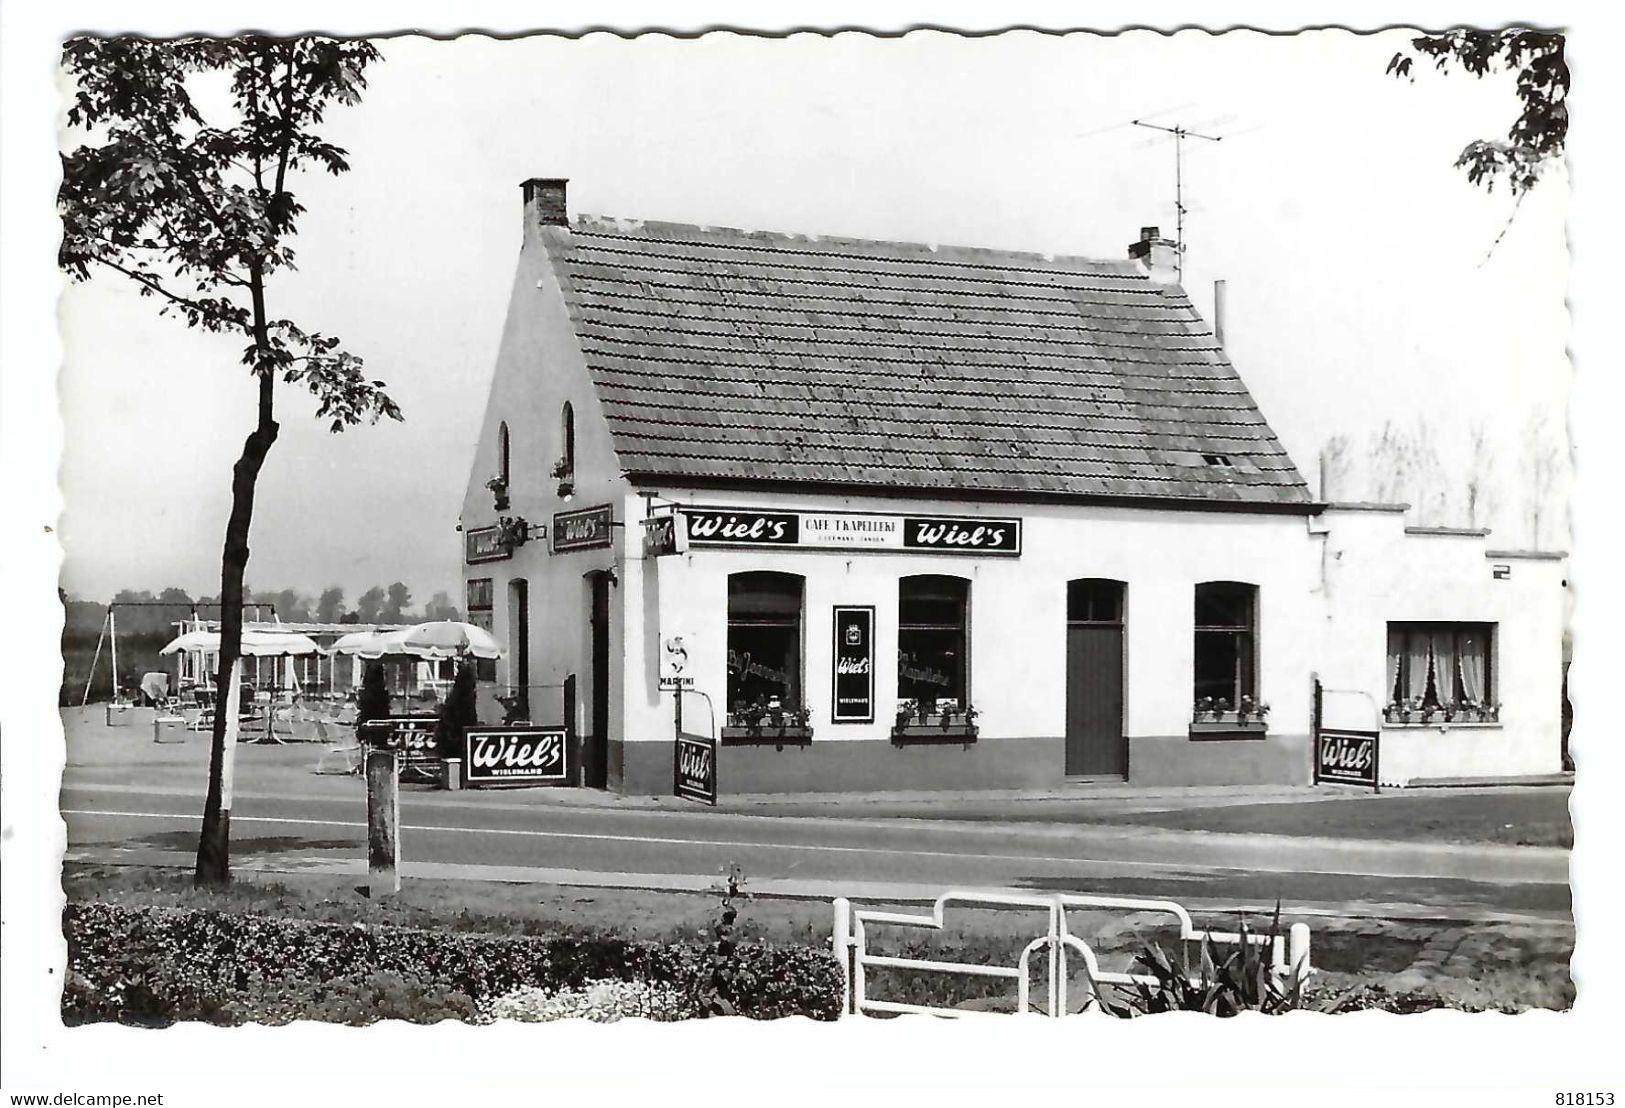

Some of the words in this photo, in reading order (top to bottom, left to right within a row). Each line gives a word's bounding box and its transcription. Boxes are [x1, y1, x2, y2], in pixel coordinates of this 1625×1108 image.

[691, 514, 788, 539] Wiel's
[917, 522, 1005, 546] Wiel's
[838, 656, 869, 674] Wiel's
[660, 677, 694, 686] MARTINI
[473, 735, 561, 768] Wiel's
[680, 743, 710, 780] Wiel's
[1322, 738, 1372, 770] Wiel's
[490, 768, 543, 776] WIELEMANS
